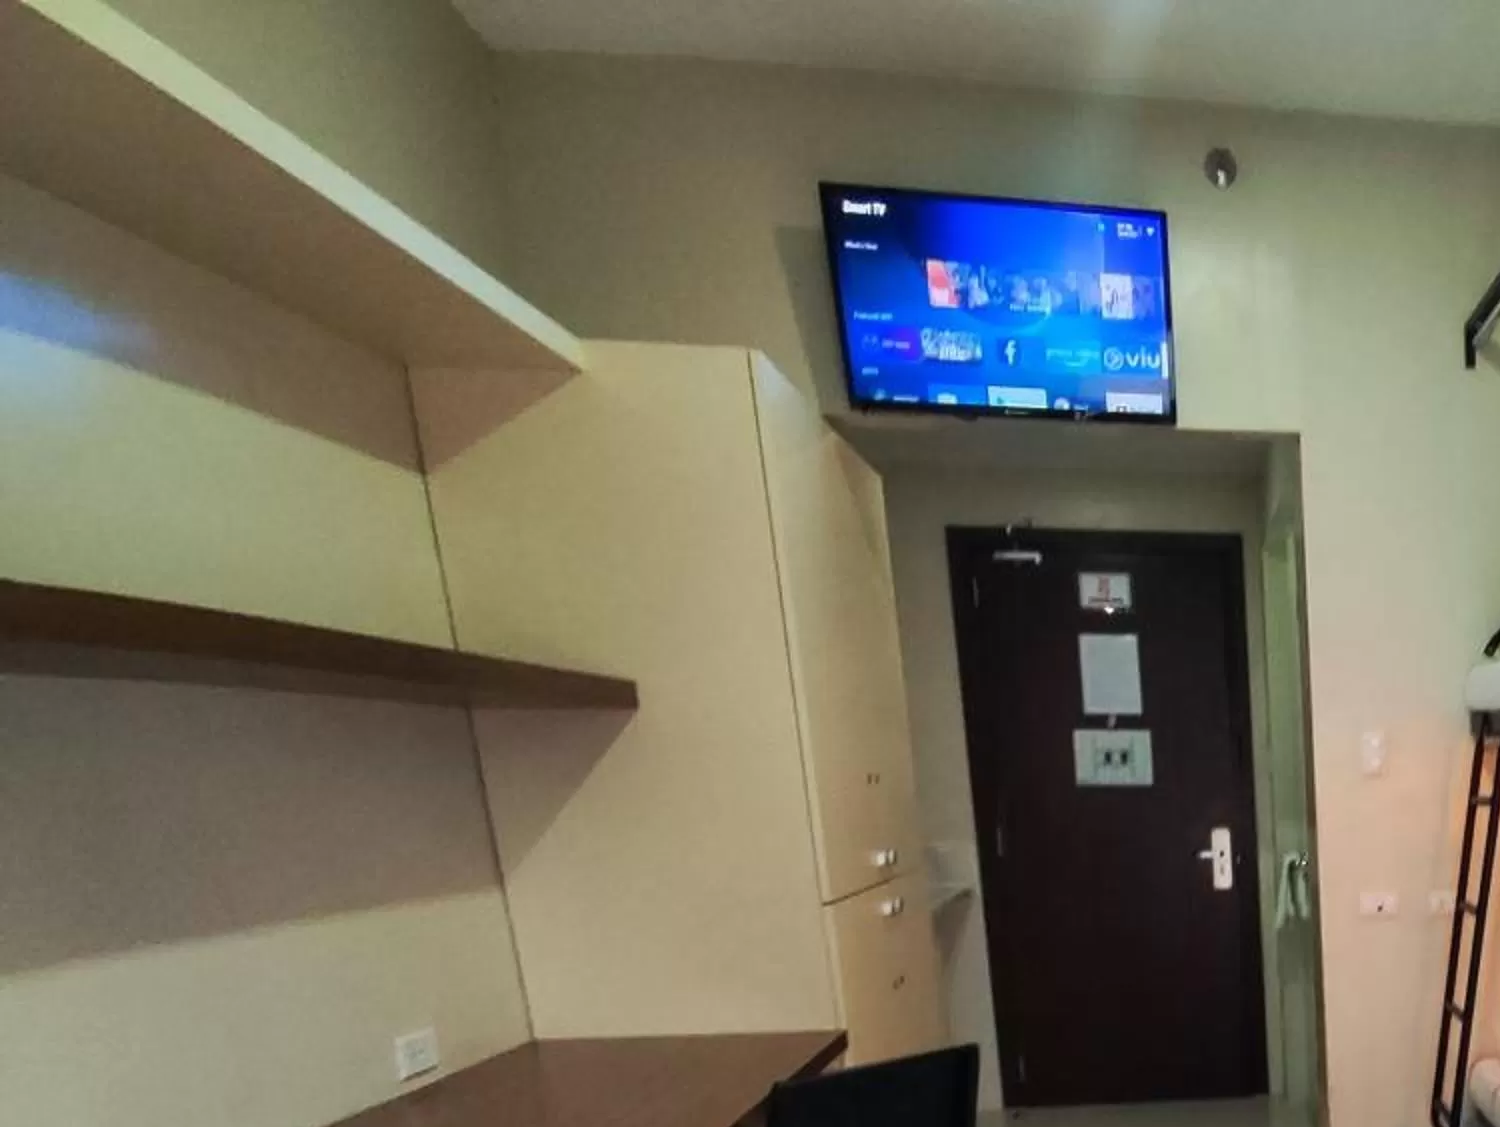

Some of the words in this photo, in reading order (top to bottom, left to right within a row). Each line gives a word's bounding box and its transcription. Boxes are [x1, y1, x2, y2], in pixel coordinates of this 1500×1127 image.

[842, 199, 871, 215] Smart
[873, 203, 887, 216] TV
[1125, 345, 1161, 369] viu
